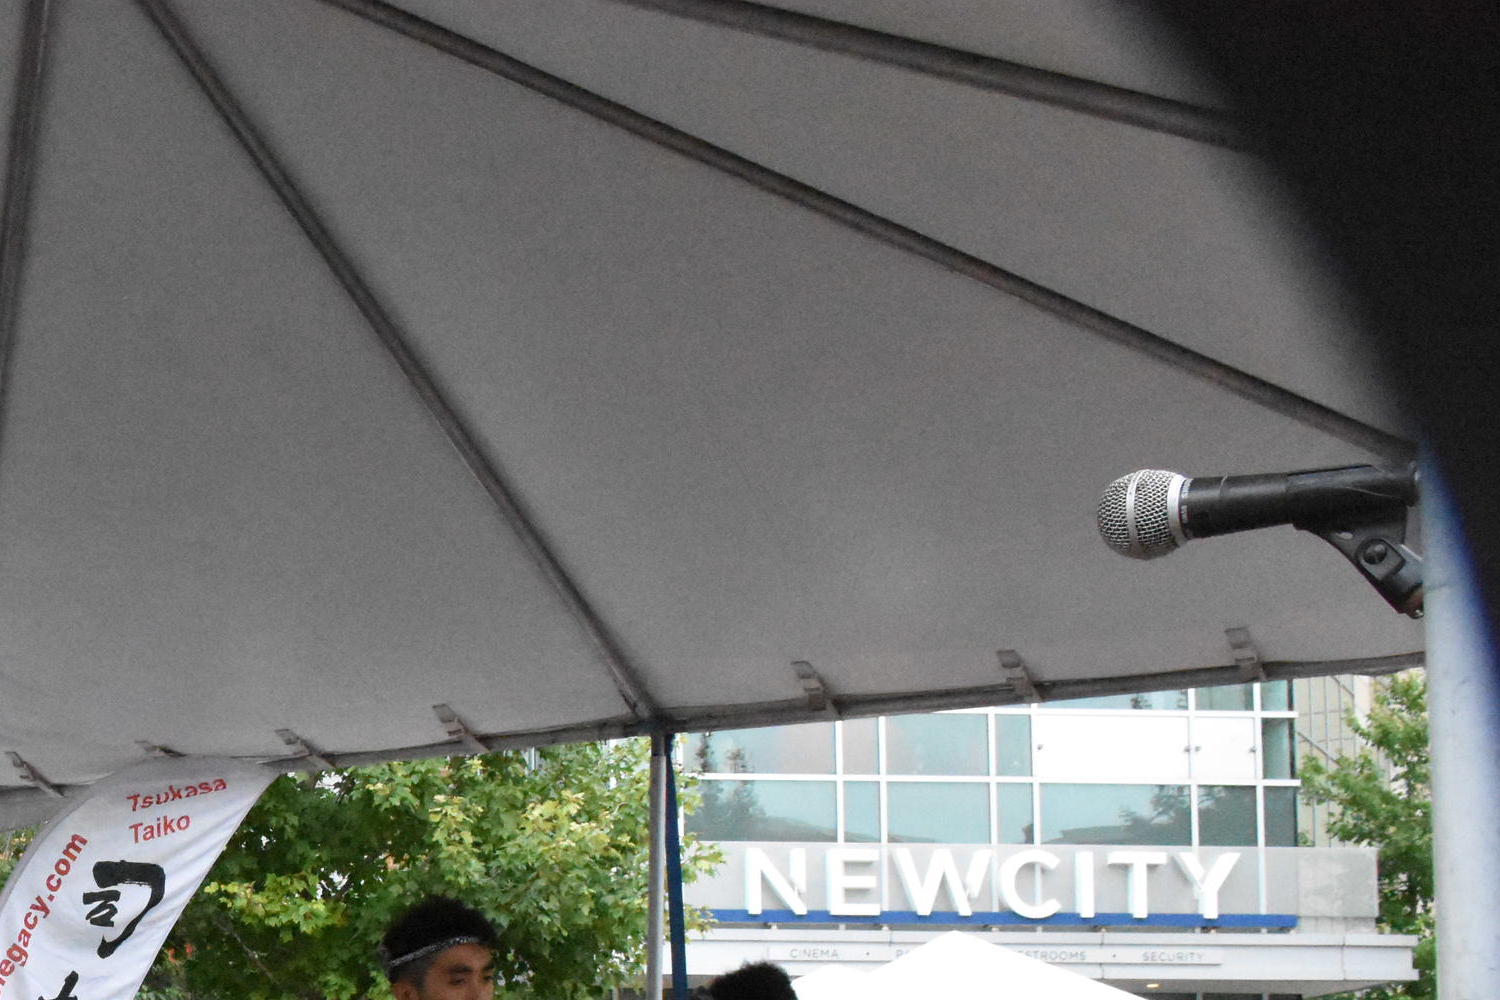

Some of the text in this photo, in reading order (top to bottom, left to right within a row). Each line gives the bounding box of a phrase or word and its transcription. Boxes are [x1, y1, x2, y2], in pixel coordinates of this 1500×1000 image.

[126, 778, 228, 812] Tsukasa
[129, 815, 191, 844] Taiko
[744, 847, 1241, 919] NEWCITY
[790, 948, 839, 959] CINEMA
[1018, 950, 1086, 962] STROOMS
[1142, 951, 1204, 962] SECURITY
